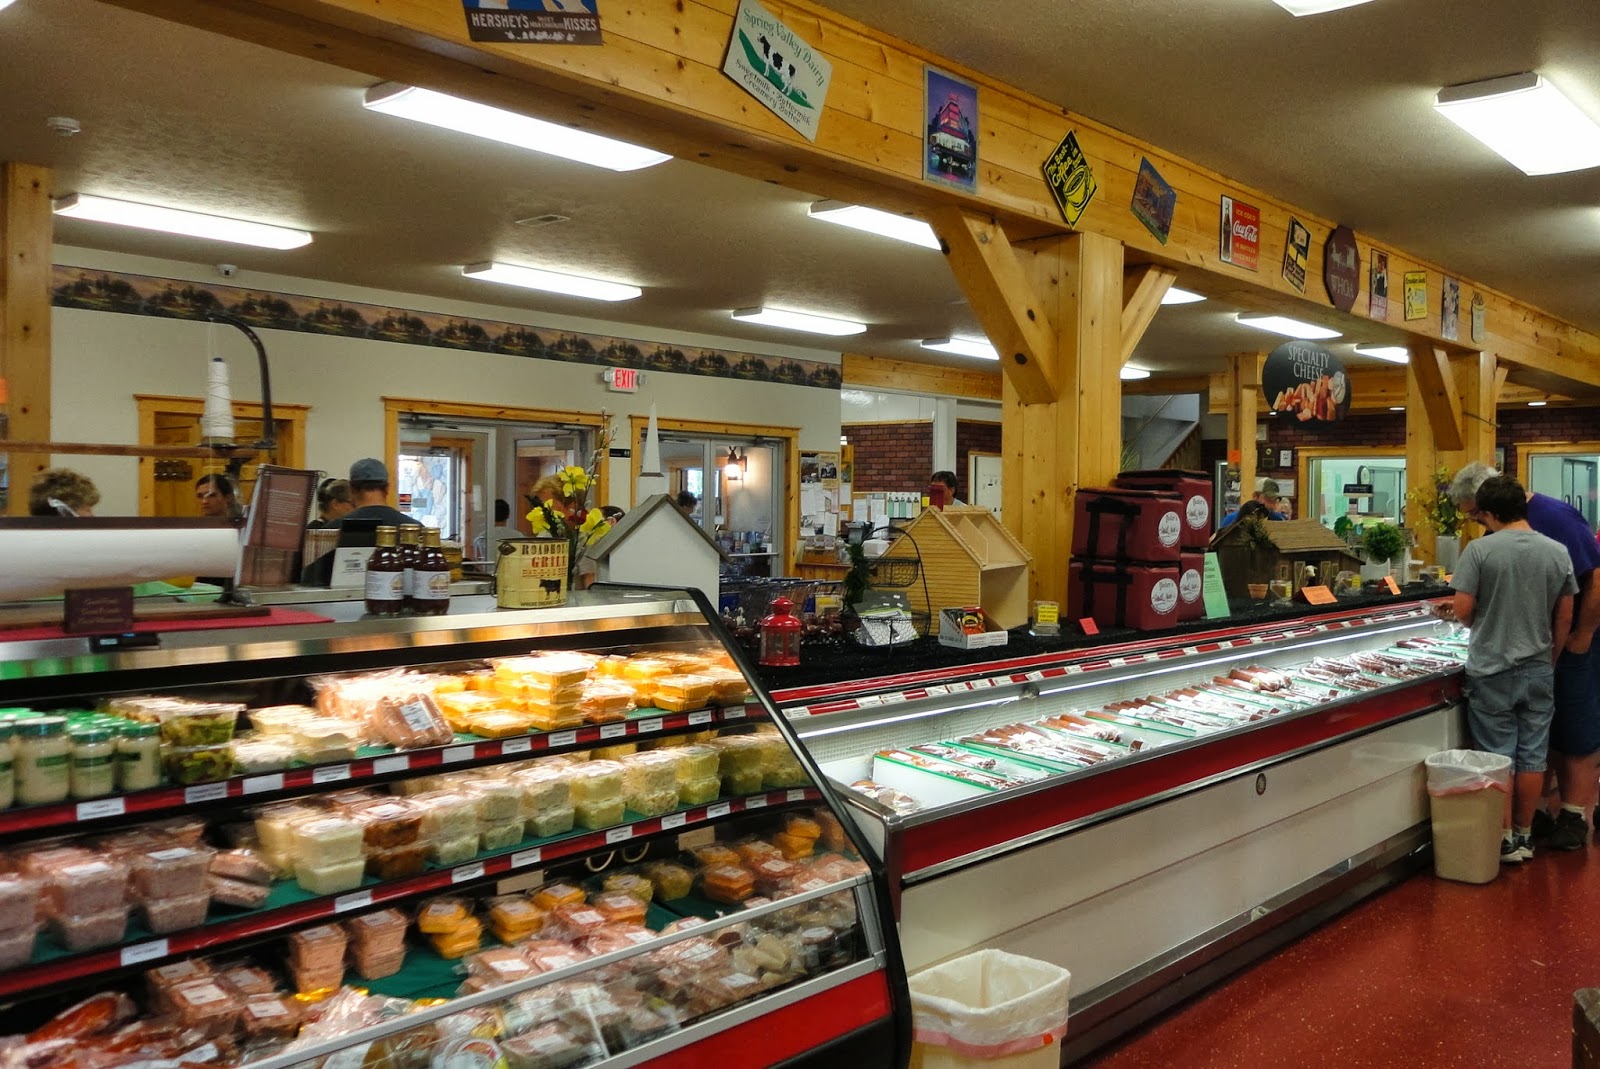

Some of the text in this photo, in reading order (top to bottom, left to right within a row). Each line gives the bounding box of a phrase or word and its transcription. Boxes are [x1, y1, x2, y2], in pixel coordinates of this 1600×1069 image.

[471, 12, 598, 31] HERSHEY'S KISSES
[743, 8, 825, 87] Spring Valley Dairy
[735, 59, 771, 92] Sweetmilk
[743, 74, 801, 124] Creamery Butter
[1052, 157, 1073, 187] Coffee
[1244, 211, 1257, 222] COLD
[1330, 274, 1355, 299] WHOA
[1288, 345, 1330, 368] SPECIALTY
[615, 369, 636, 388] EXIT
[1293, 362, 1324, 380] CHEESE
